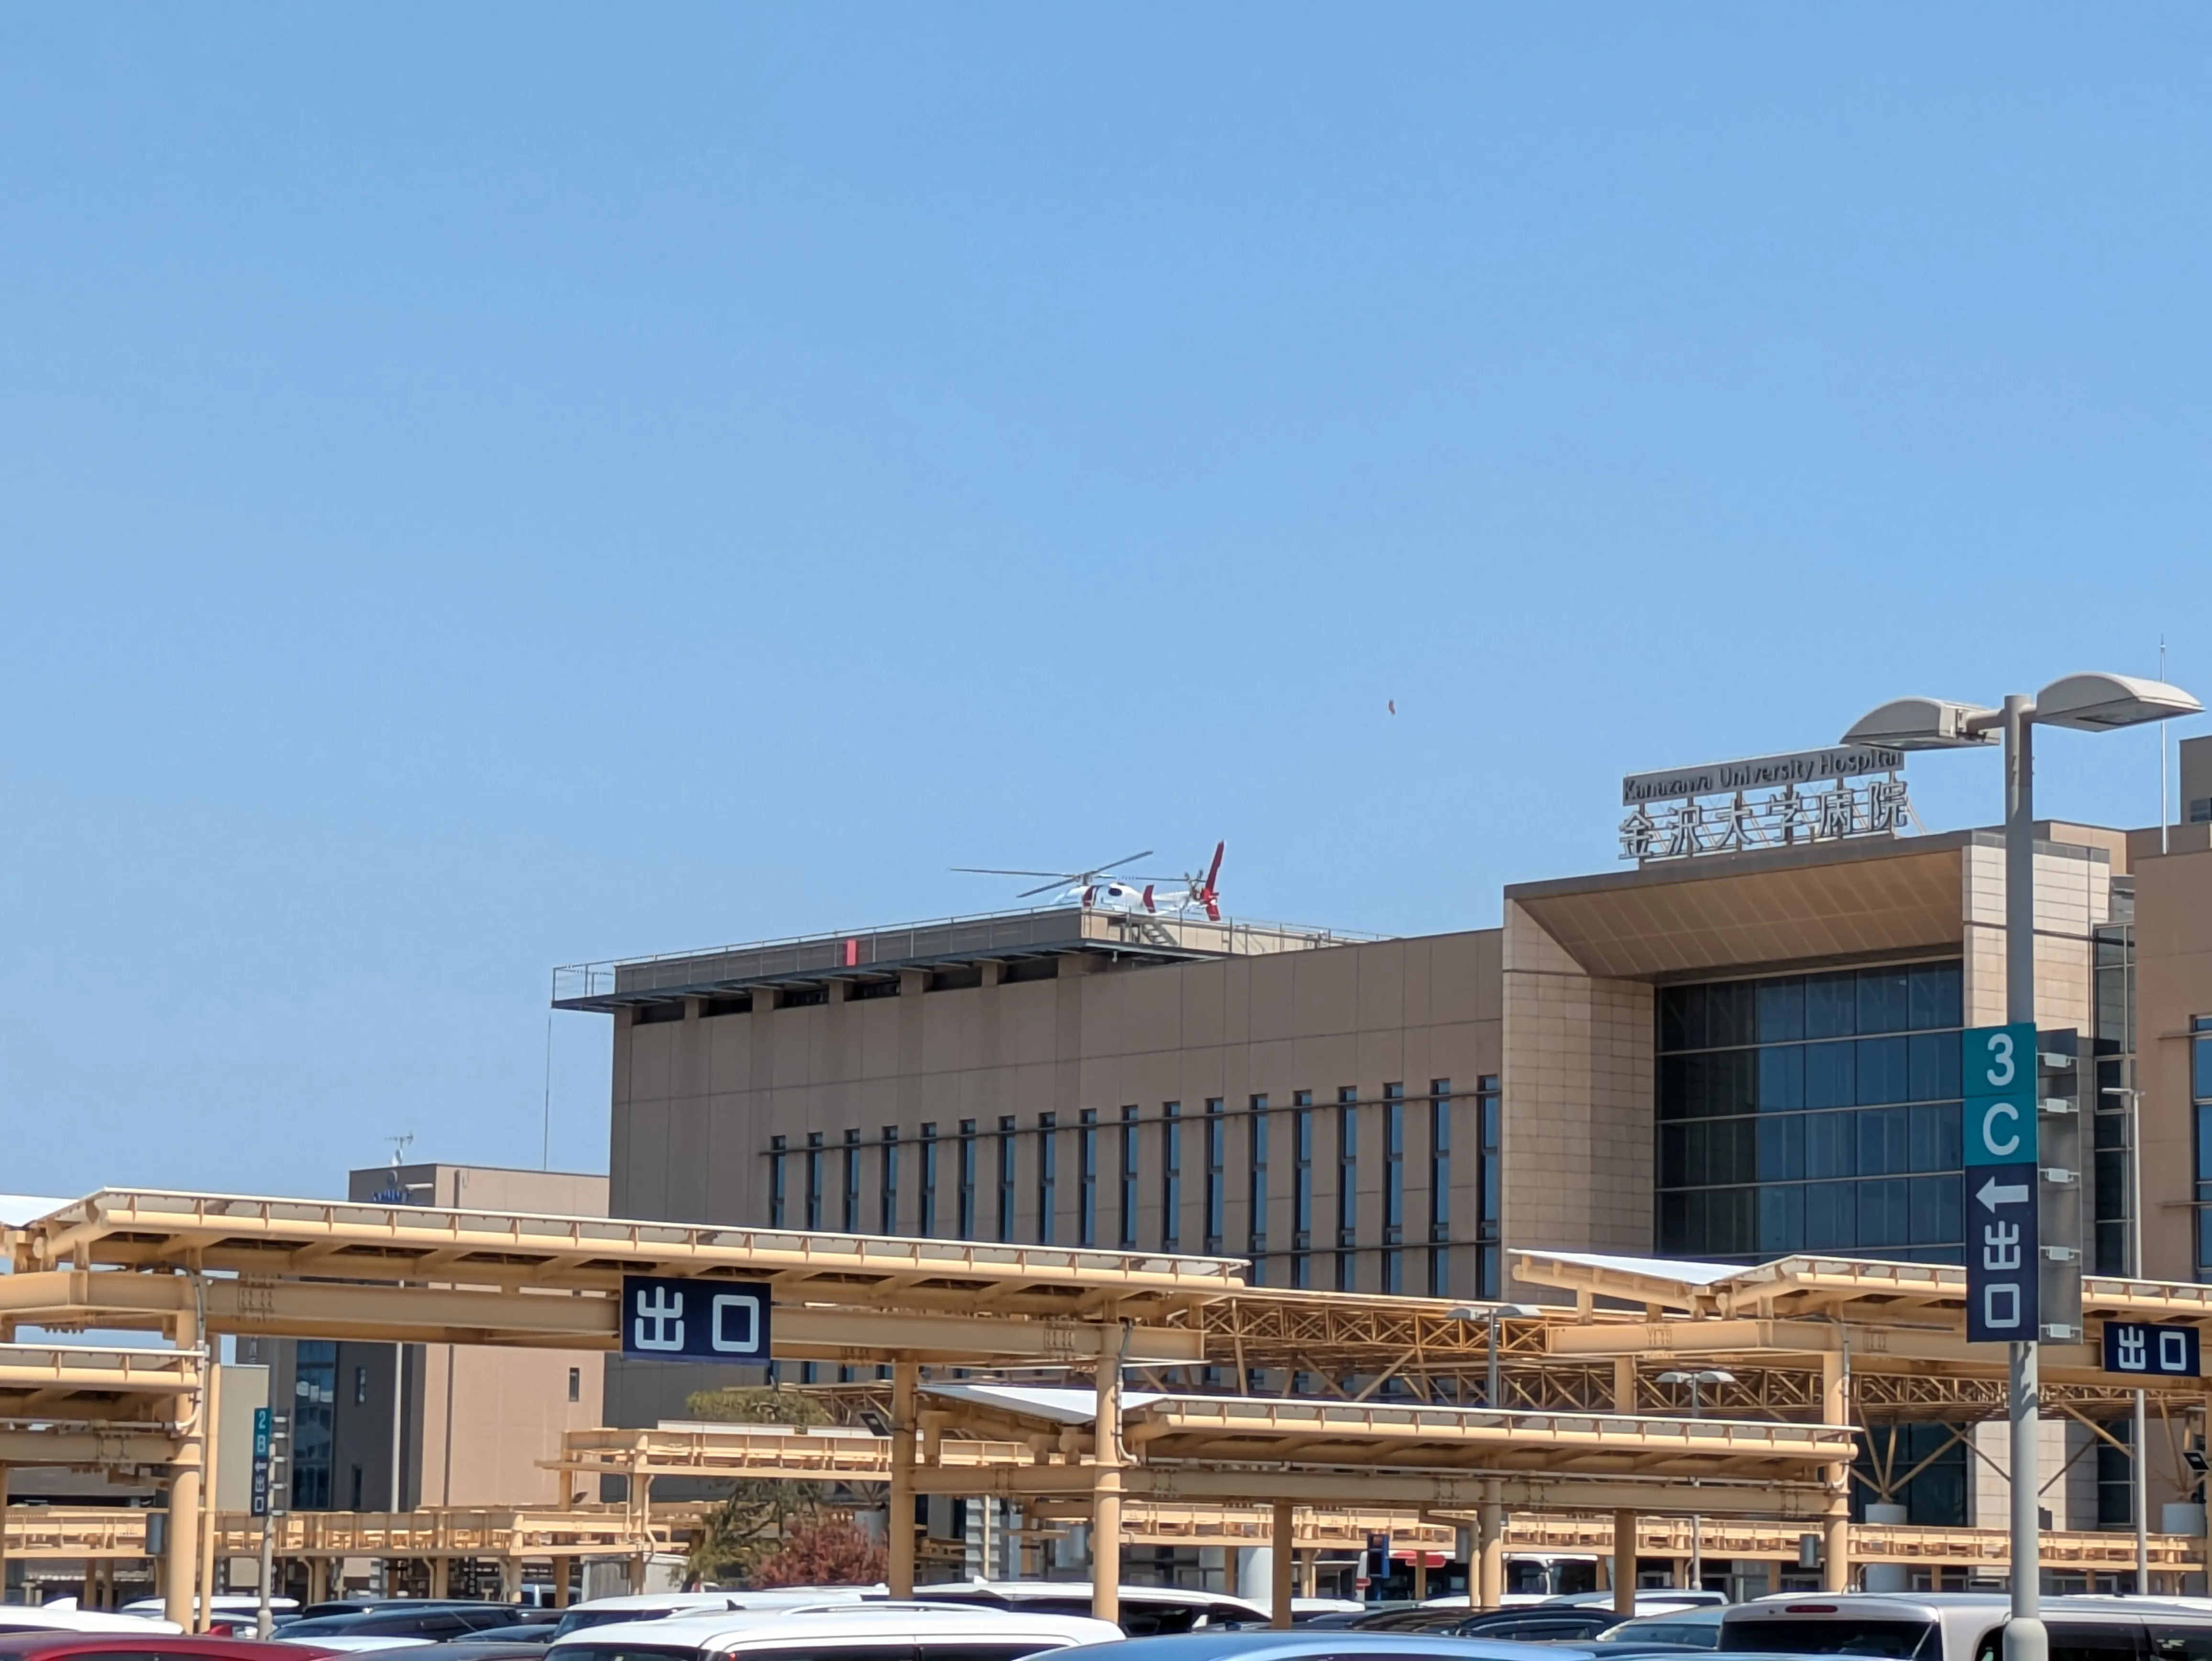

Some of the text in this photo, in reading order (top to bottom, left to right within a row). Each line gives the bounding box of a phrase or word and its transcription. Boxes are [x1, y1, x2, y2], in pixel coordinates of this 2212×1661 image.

[1625, 749, 1901, 801] Kanazawa University Hospital
[1618, 780, 1908, 860] 金沢大学病院
[1986, 1032, 2015, 1086] 3
[1982, 1102, 2020, 1156] C
[1983, 1220, 2021, 1329] 出口
[635, 1286, 760, 1353] 出口
[2118, 1326, 2187, 1371] 出口
[257, 1434, 266, 1452] B
[258, 1410, 266, 1429] 2
[254, 1474, 265, 1512] 出口
